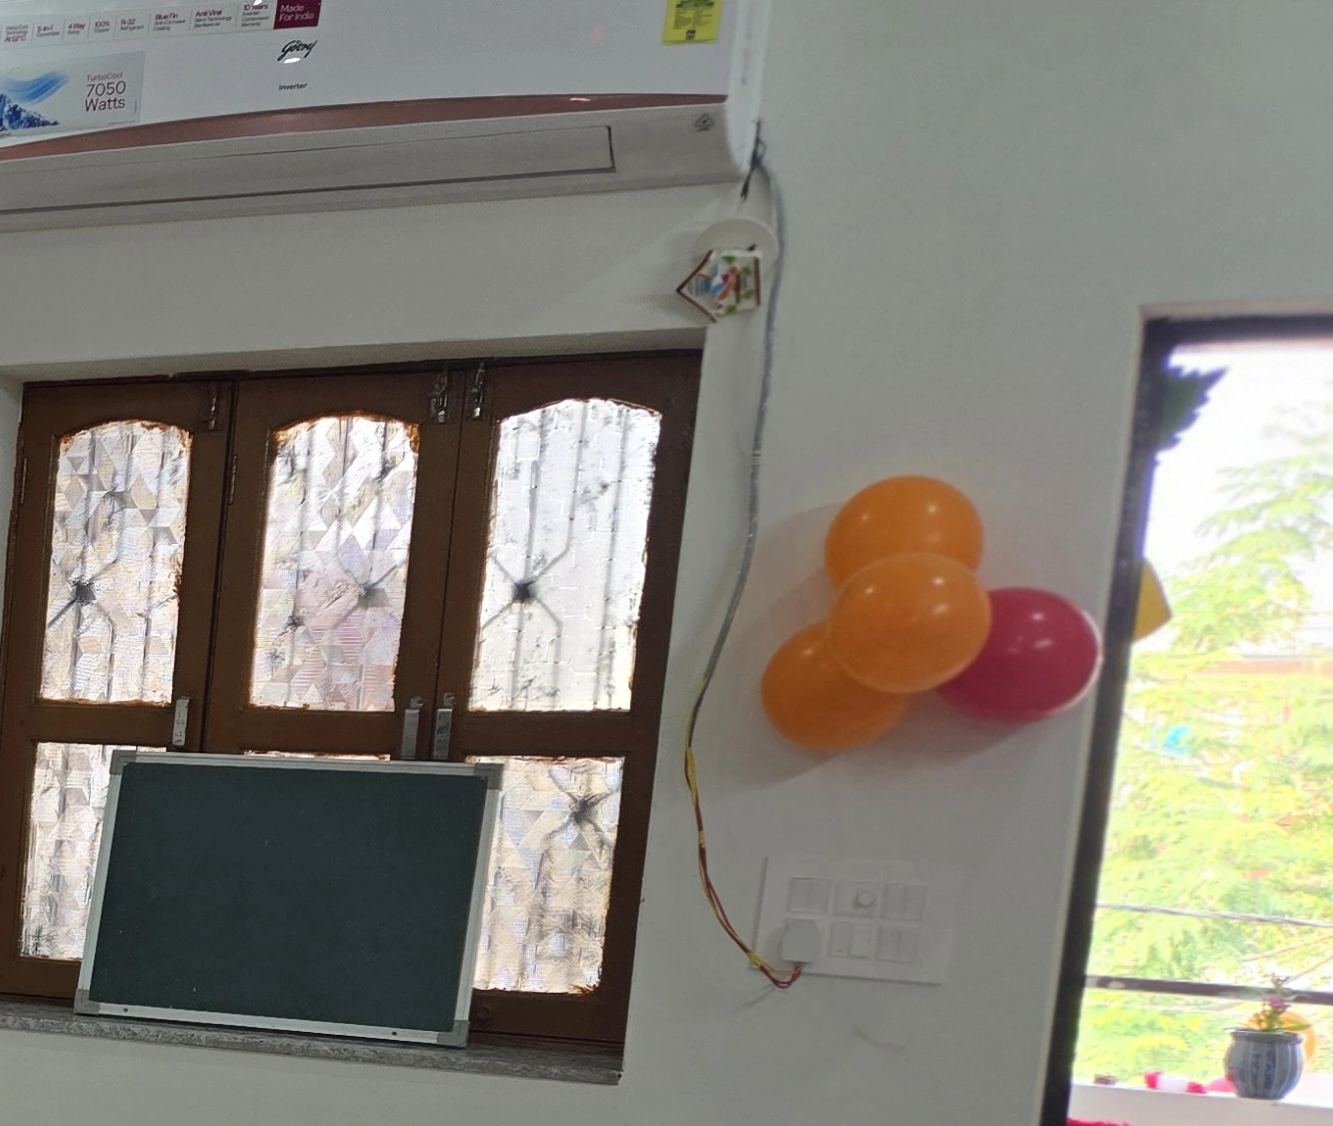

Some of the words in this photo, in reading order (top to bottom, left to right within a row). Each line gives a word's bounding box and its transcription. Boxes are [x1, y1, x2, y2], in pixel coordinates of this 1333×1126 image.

[280, 4, 304, 13] Made
[279, 13, 294, 22] For
[294, 12, 315, 20] India
[86, 71, 123, 82] TurboCool
[86, 81, 126, 98] 7050
[278, 83, 308, 91] Inverter
[85, 97, 126, 112] Watts
